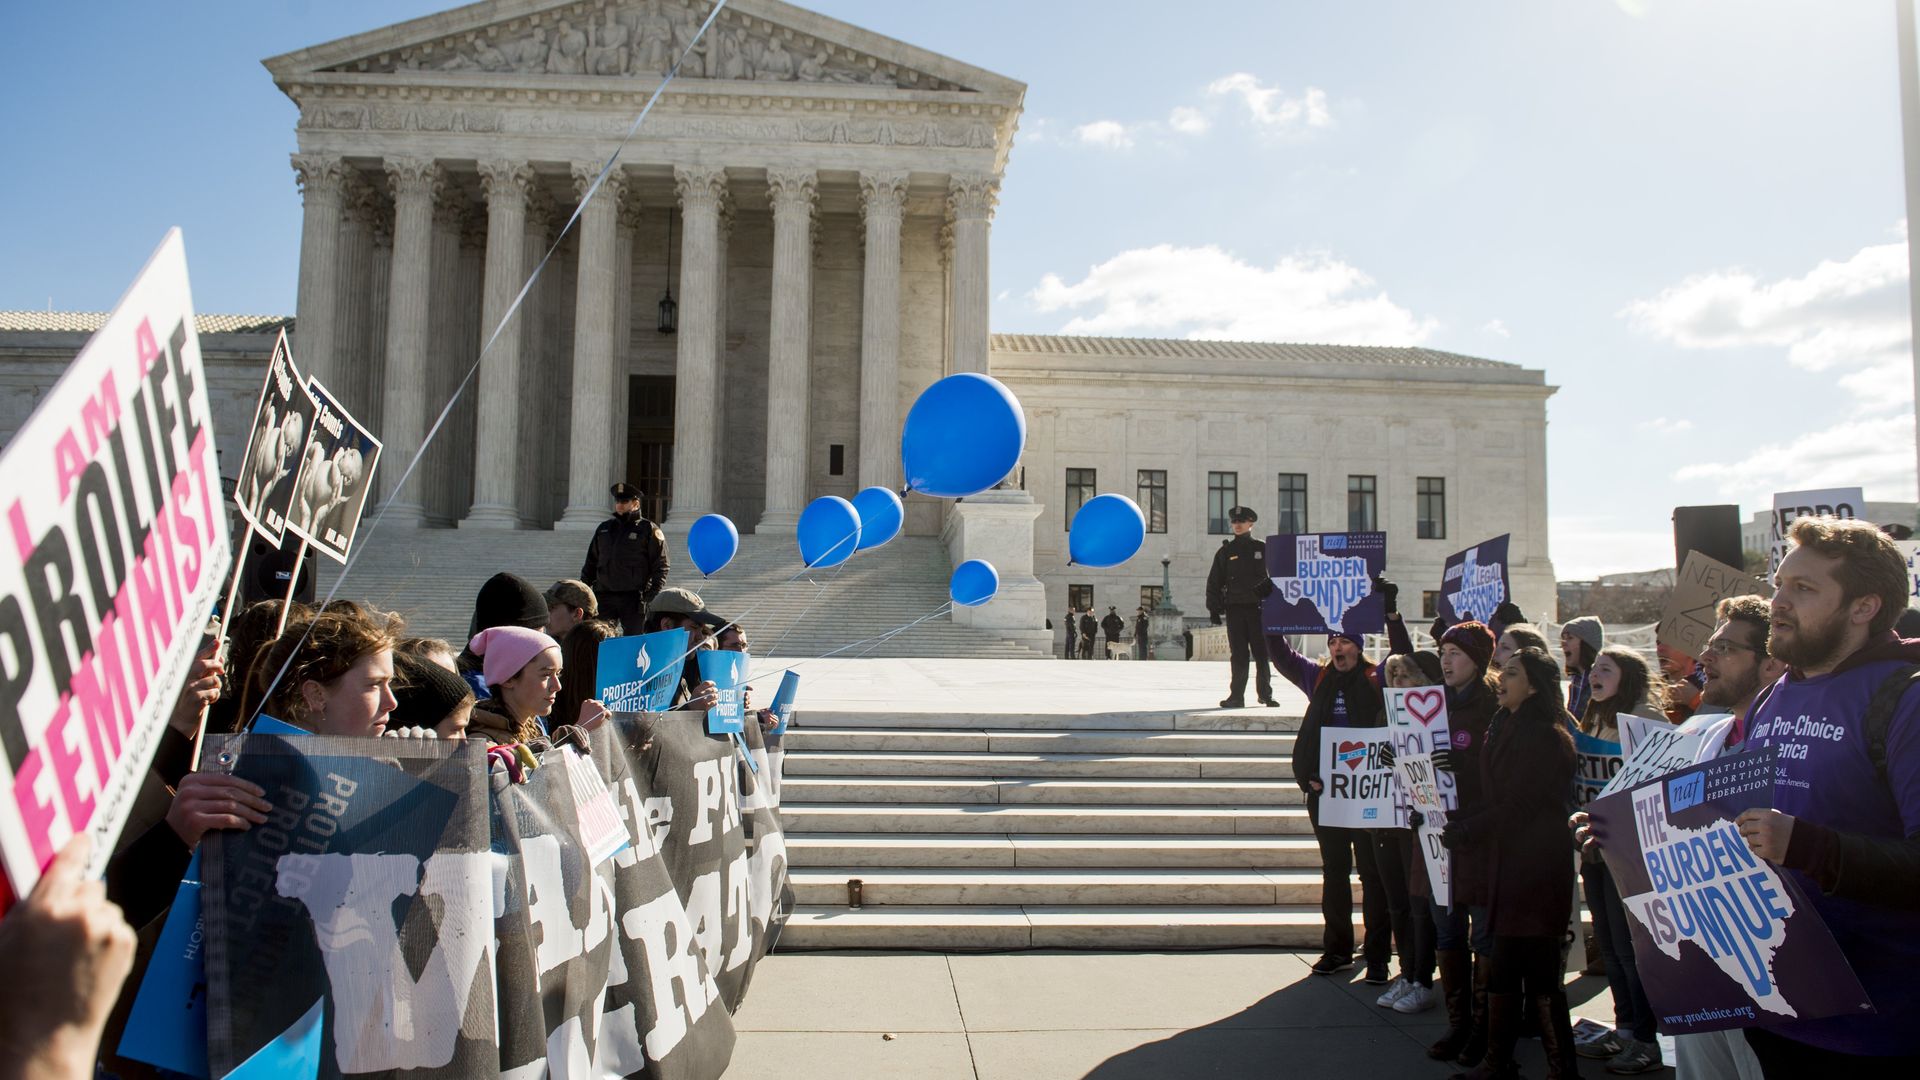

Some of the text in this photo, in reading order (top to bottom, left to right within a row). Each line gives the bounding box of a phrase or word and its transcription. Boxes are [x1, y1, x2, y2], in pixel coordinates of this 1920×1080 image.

[7, 315, 160, 567] I AM A
[1298, 540, 1318, 560] THE
[1298, 560, 1365, 579] BURDEN
[1285, 578, 1367, 624] IS UNDUE
[1267, 625, 1324, 633] www.prochoice.org
[13, 426, 216, 876] FEMINIST
[602, 680, 643, 702] PROTECT
[1755, 722, 1771, 739] am
[1771, 714, 1845, 742] Pro-Choice
[1331, 742, 1337, 770] I
[1632, 730, 1684, 767] MY
[1673, 754, 1771, 808] naf NATIONAL
[1706, 778, 1769, 802] FEDERATION
[1707, 766, 1771, 789] ABORTION
[1635, 792, 1668, 849] THE
[1645, 824, 1757, 894] BURDEN
[1644, 898, 1677, 945] IS
[1667, 871, 1789, 997] UNDUE
[1663, 1005, 1756, 1027] www.prochoice.org
